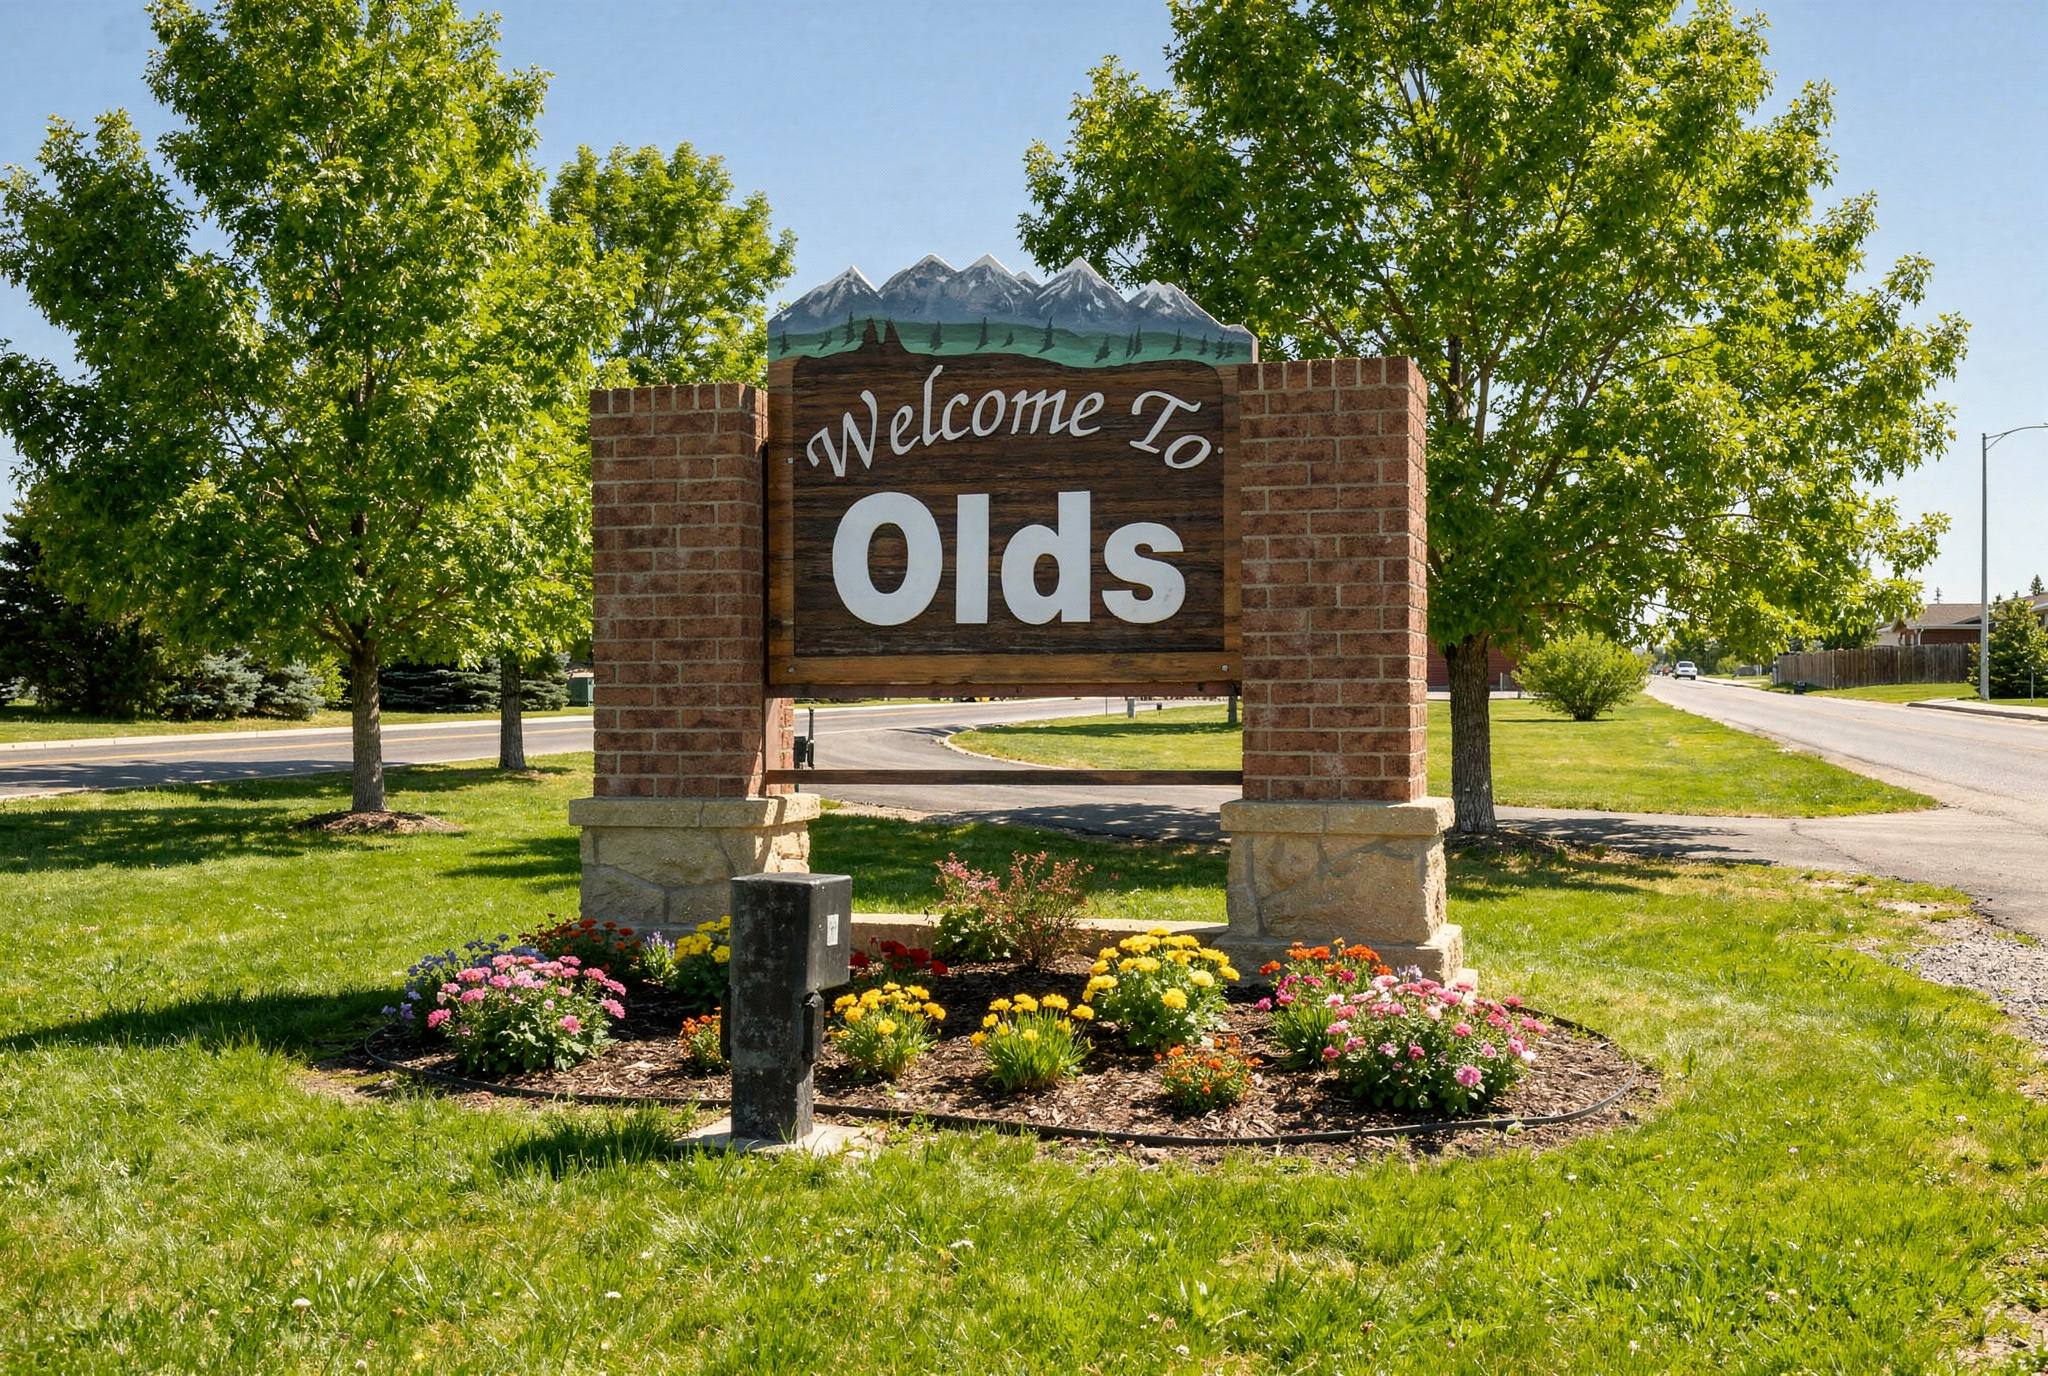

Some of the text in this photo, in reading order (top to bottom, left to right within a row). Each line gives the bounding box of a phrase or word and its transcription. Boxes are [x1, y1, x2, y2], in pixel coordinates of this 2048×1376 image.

[806, 365, 1212, 477] Welcome To
[832, 490, 1186, 625] Olds
